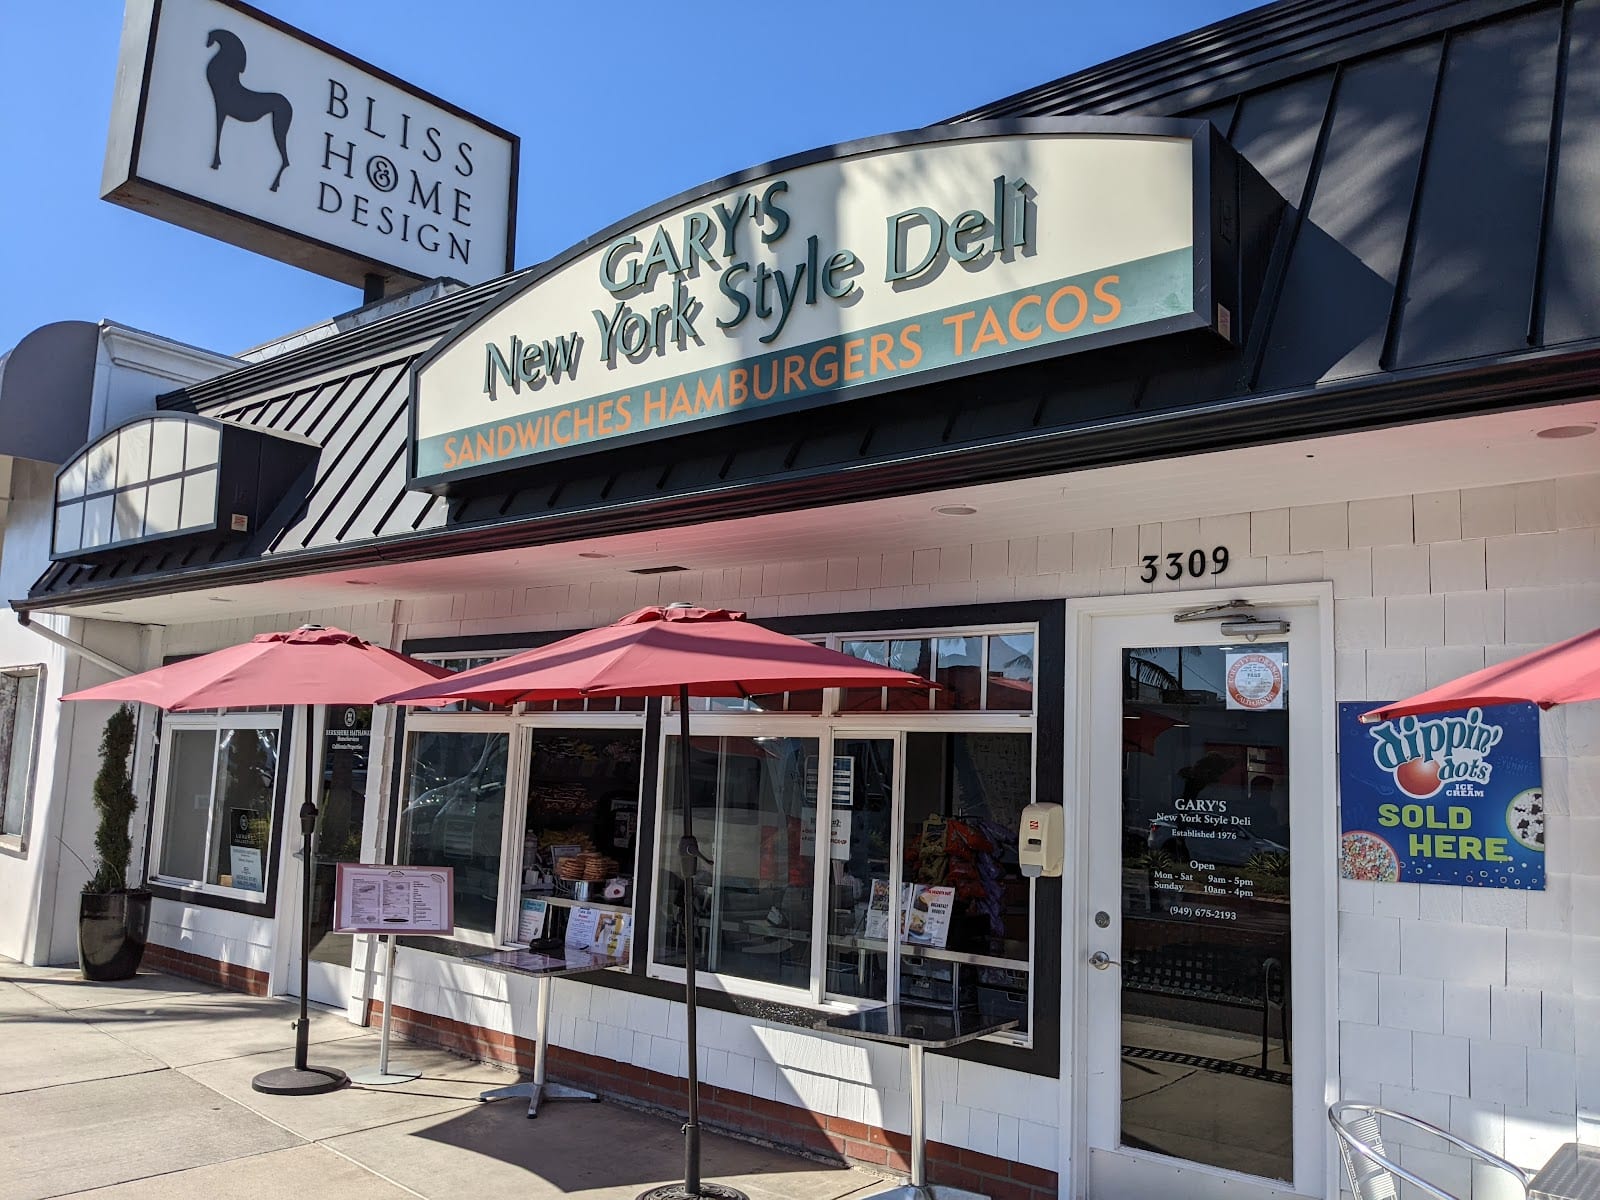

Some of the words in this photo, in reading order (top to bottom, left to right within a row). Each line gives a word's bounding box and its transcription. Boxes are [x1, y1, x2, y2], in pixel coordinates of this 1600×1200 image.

[326, 79, 474, 177] BLISS
[317, 181, 472, 265] DESIGN
[600, 180, 790, 292] GARY'S
[483, 331, 578, 393] New
[591, 279, 697, 362] York
[715, 234, 857, 344] Style
[885, 175, 1031, 283] Deli
[443, 395, 632, 469] SANDWICHES
[643, 325, 922, 422] HAMBURGERS
[943, 275, 1122, 355] TACOS
[1140, 546, 1229, 583] 3309
[1439, 756, 1489, 780] dots
[1175, 799, 1227, 812] GARY'S
[1156, 812, 1177, 822] New
[1180, 814, 1202, 823] York
[1204, 815, 1228, 826] Style
[1231, 816, 1251, 826] Deli
[1378, 803, 1472, 830] SOLD
[1171, 829, 1215, 839] Established
[1218, 831, 1237, 840] 1976
[1190, 860, 1215, 871] Open
[1154, 871, 1173, 879] Mon
[1180, 872, 1193, 881] Sat
[1208, 874, 1226, 884] 9am
[1234, 876, 1254, 887] 5pm
[1154, 881, 1184, 892] Sunday
[1203, 885, 1226, 895] 10am
[1234, 888, 1254, 898] 4pm
[1169, 906, 1192, 917] (949)
[1195, 908, 1237, 920] 675-2193
